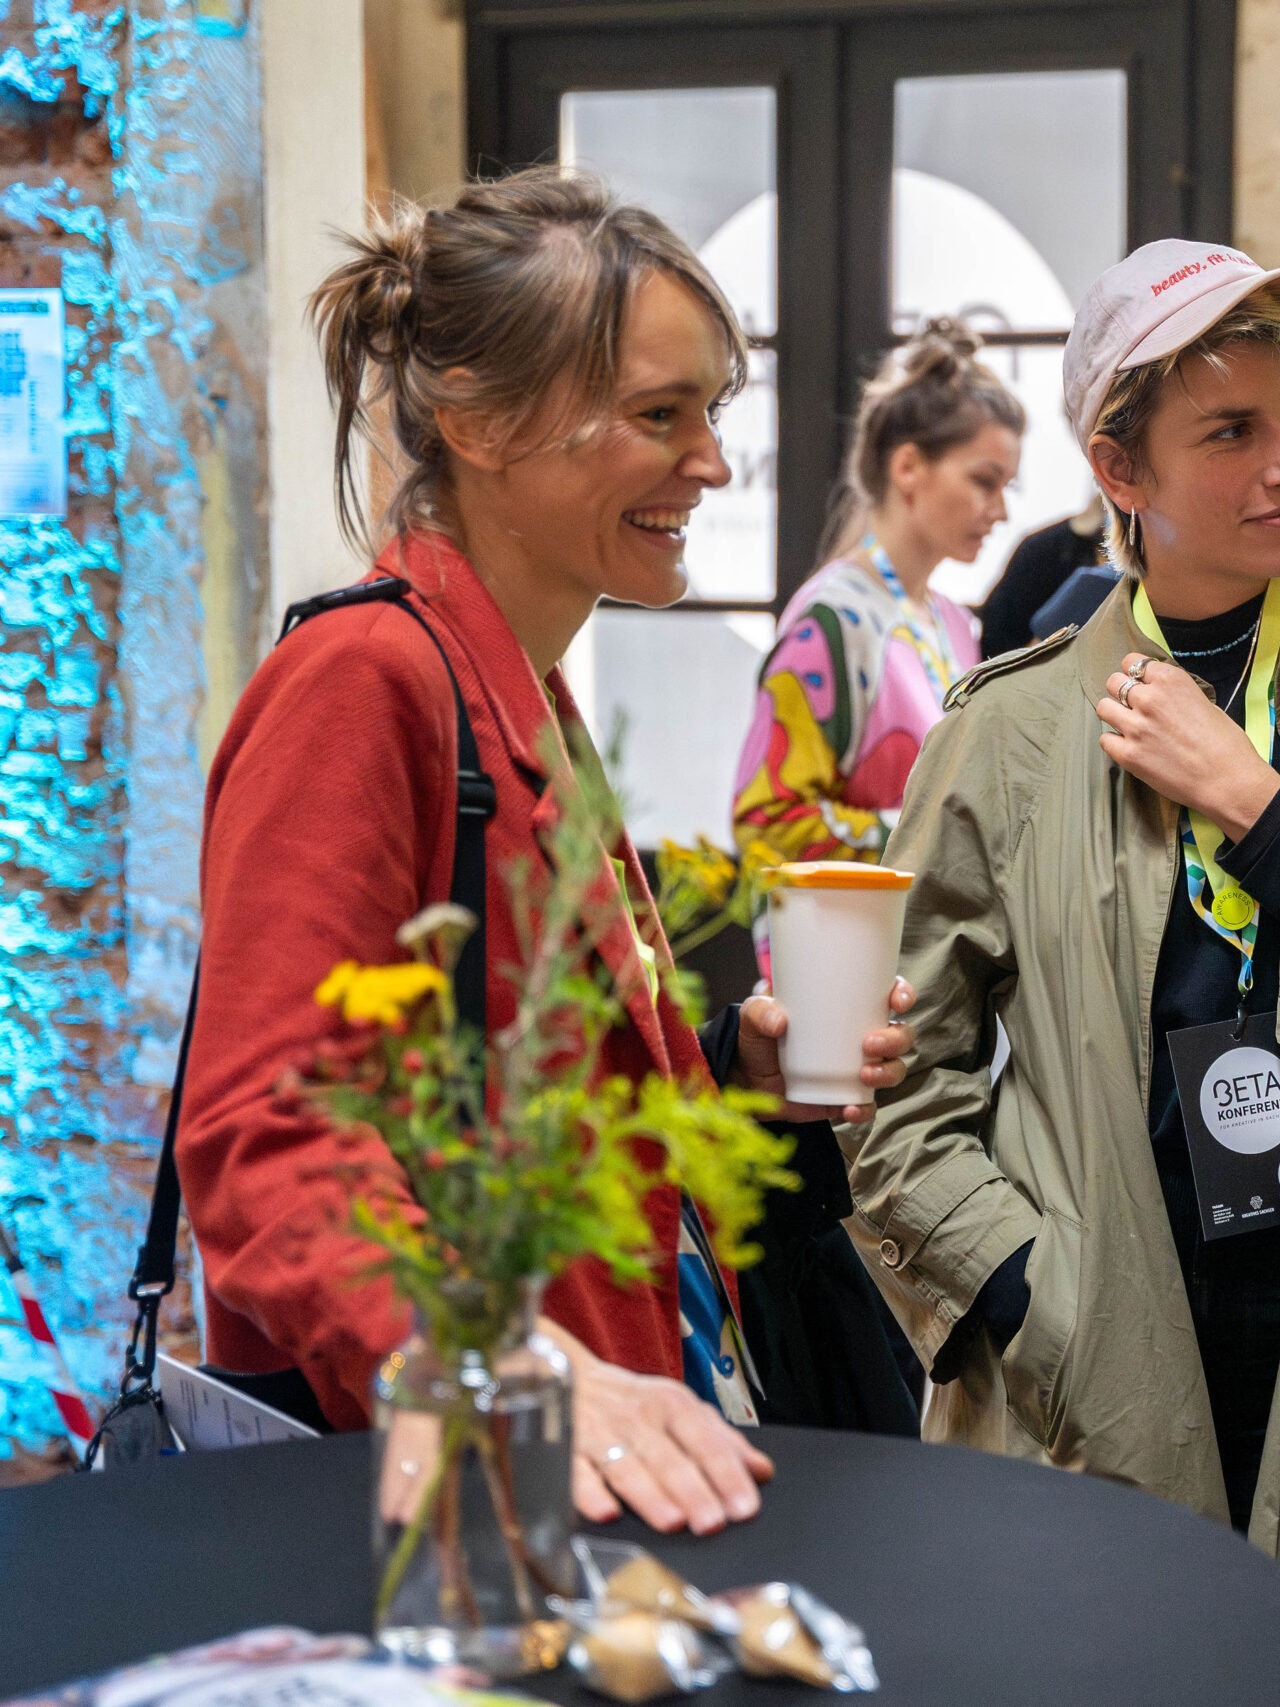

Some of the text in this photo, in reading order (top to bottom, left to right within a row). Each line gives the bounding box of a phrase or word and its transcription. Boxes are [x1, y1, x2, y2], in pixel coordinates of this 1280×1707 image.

[1151, 262, 1207, 296] beauty,
[1207, 253, 1226, 265] fit
[1216, 892, 1251, 916] AWARENESS
